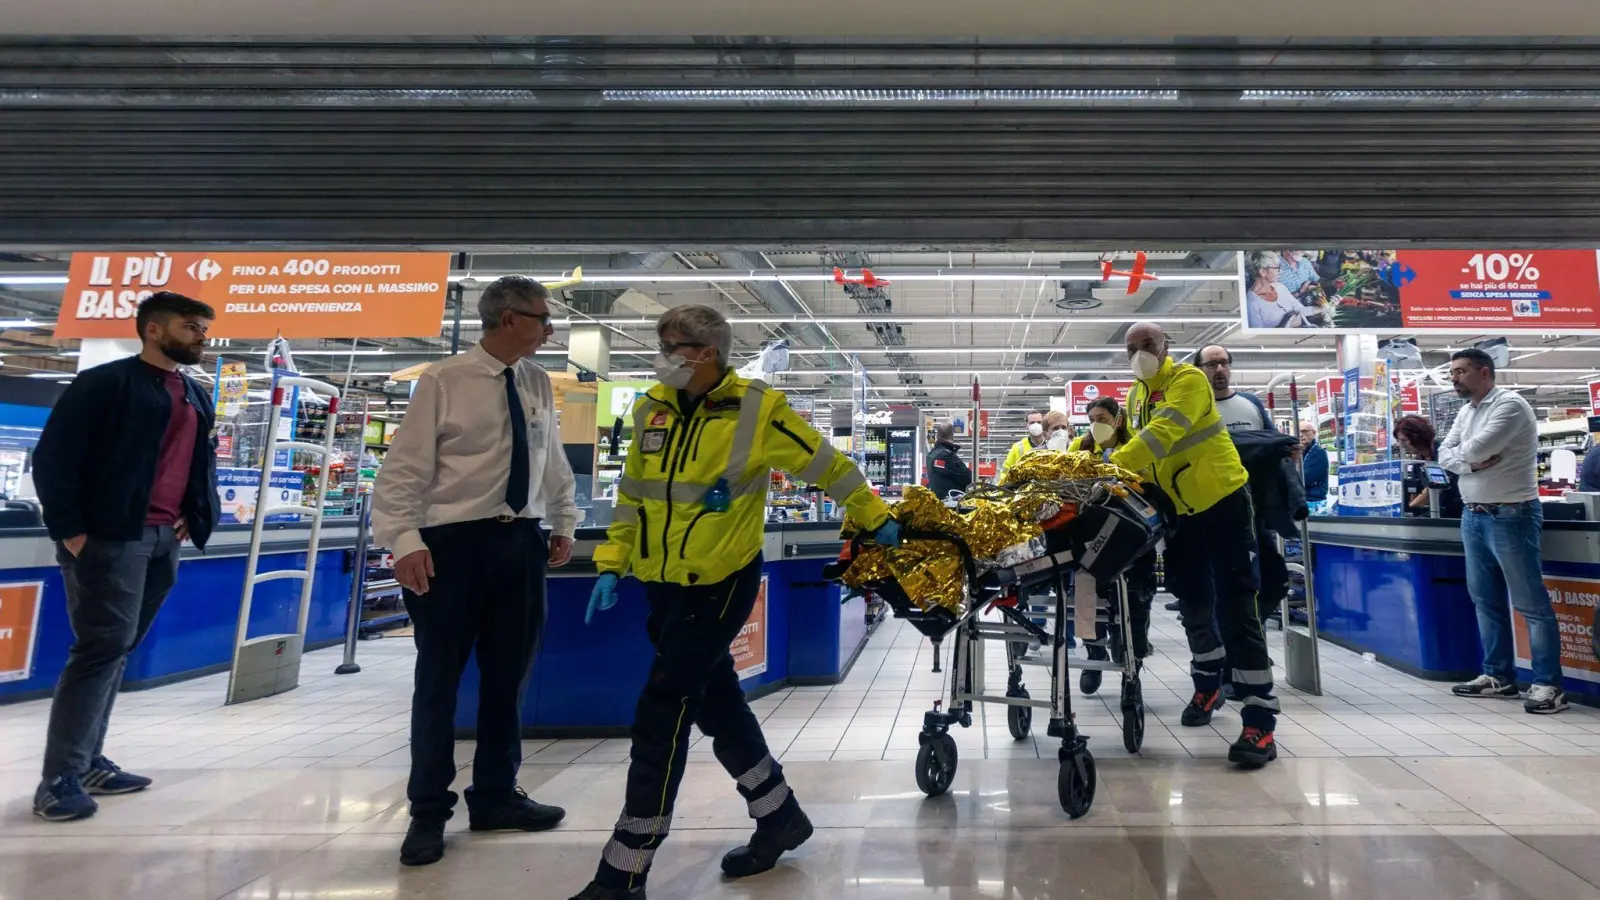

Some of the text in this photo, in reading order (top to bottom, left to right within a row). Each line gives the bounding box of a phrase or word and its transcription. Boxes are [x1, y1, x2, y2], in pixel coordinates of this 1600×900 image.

[88, 252, 173, 287] IL PIÙ
[232, 259, 401, 276] FINO A 400 PRODOTTI
[1461, 252, 1540, 281] -10%
[229, 282, 440, 295] PER UNA SPESA CON IL MASSIMO
[1470, 282, 1483, 290] hai
[1484, 282, 1497, 291] più
[1499, 282, 1506, 290] di
[1507, 282, 1518, 290] 60
[1519, 282, 1537, 290] anni
[75, 289, 171, 320] BASS
[224, 302, 362, 313] DELLA CONVENIENZA
[1093, 534, 1108, 554] ZOLL
[1555, 613, 1573, 621] FINO
[1558, 622, 1593, 637] RODO
[1574, 636, 1593, 645] SPES
